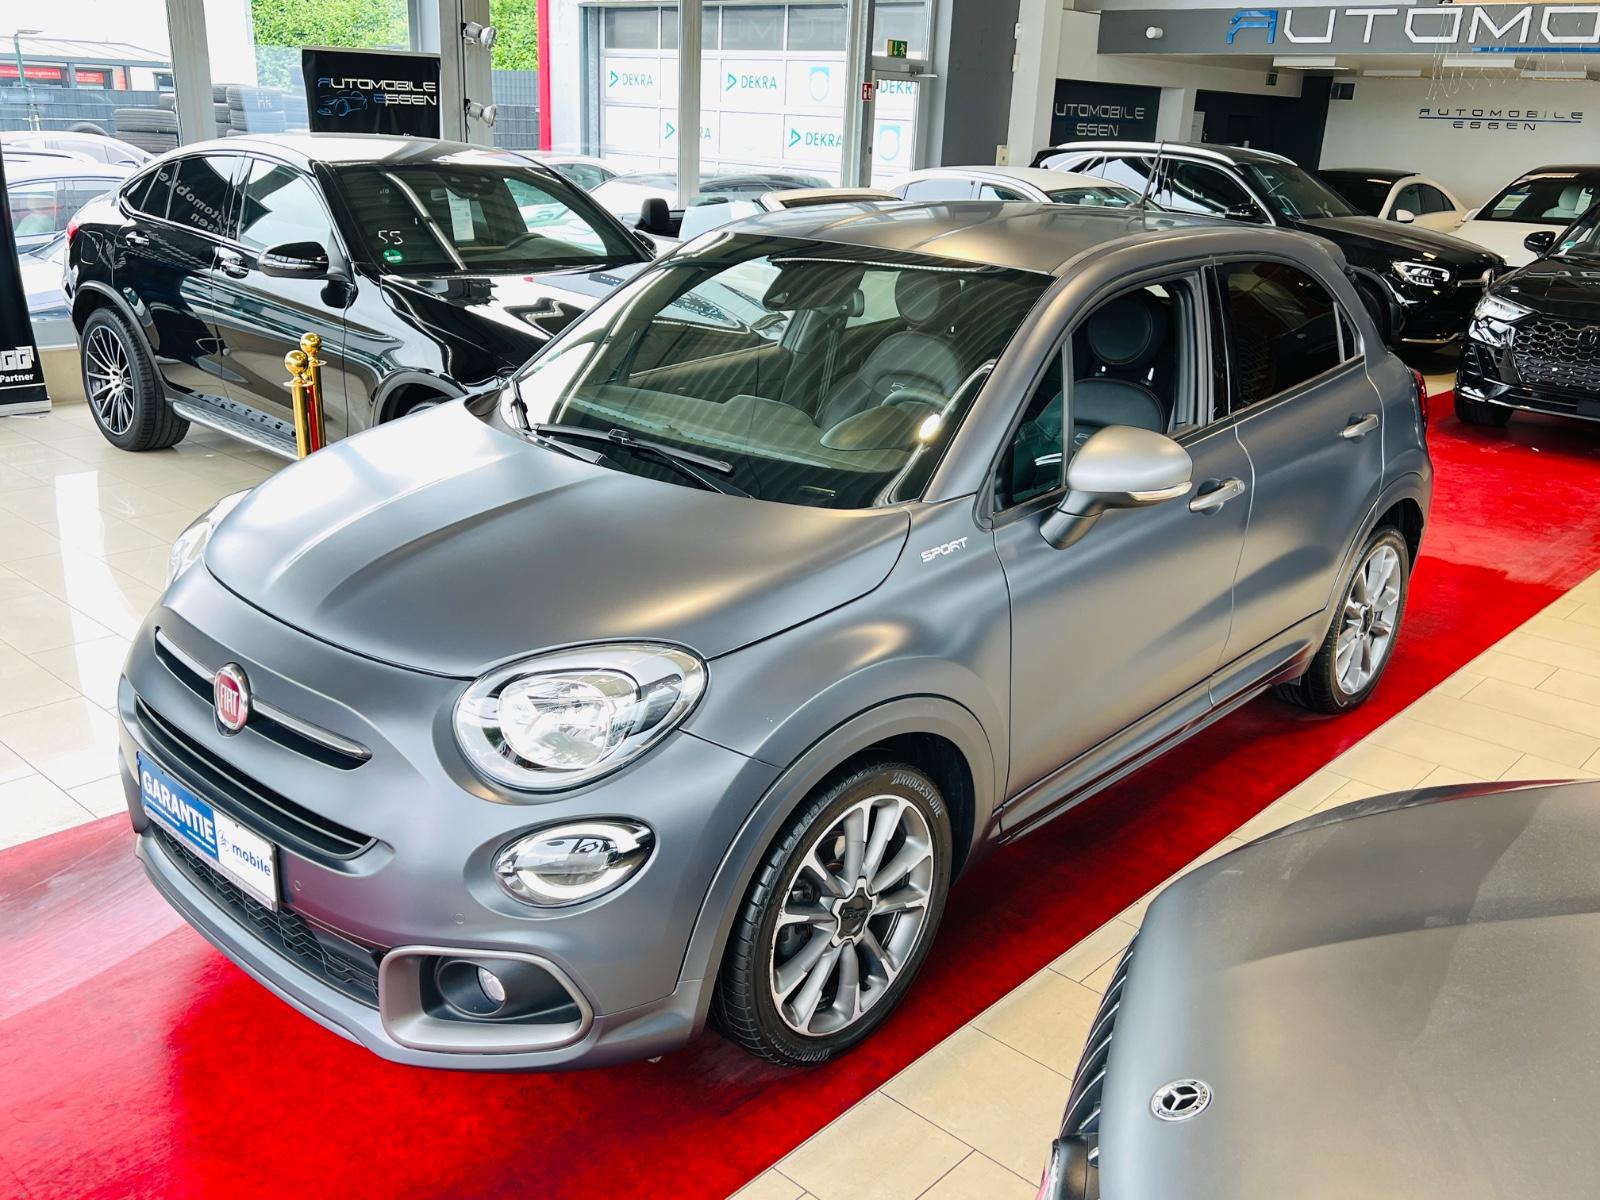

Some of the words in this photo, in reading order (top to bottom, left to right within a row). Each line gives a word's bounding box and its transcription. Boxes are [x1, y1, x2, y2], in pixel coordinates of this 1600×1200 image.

[317, 77, 436, 92] AUTOMOBILE
[622, 73, 653, 87] DEKRA
[741, 75, 777, 90] DEKRA
[880, 80, 913, 95] DEKR
[373, 93, 437, 106] ESSEN
[1055, 103, 1145, 119] UTOMOBILE
[1419, 108, 1583, 120] AUTOMOBILE
[1453, 121, 1537, 131] ESSEN
[921, 536, 968, 563] SPORT
[220, 683, 239, 717] FIAT
[142, 770, 216, 846] GARANTIE
[232, 844, 271, 877] mobile
